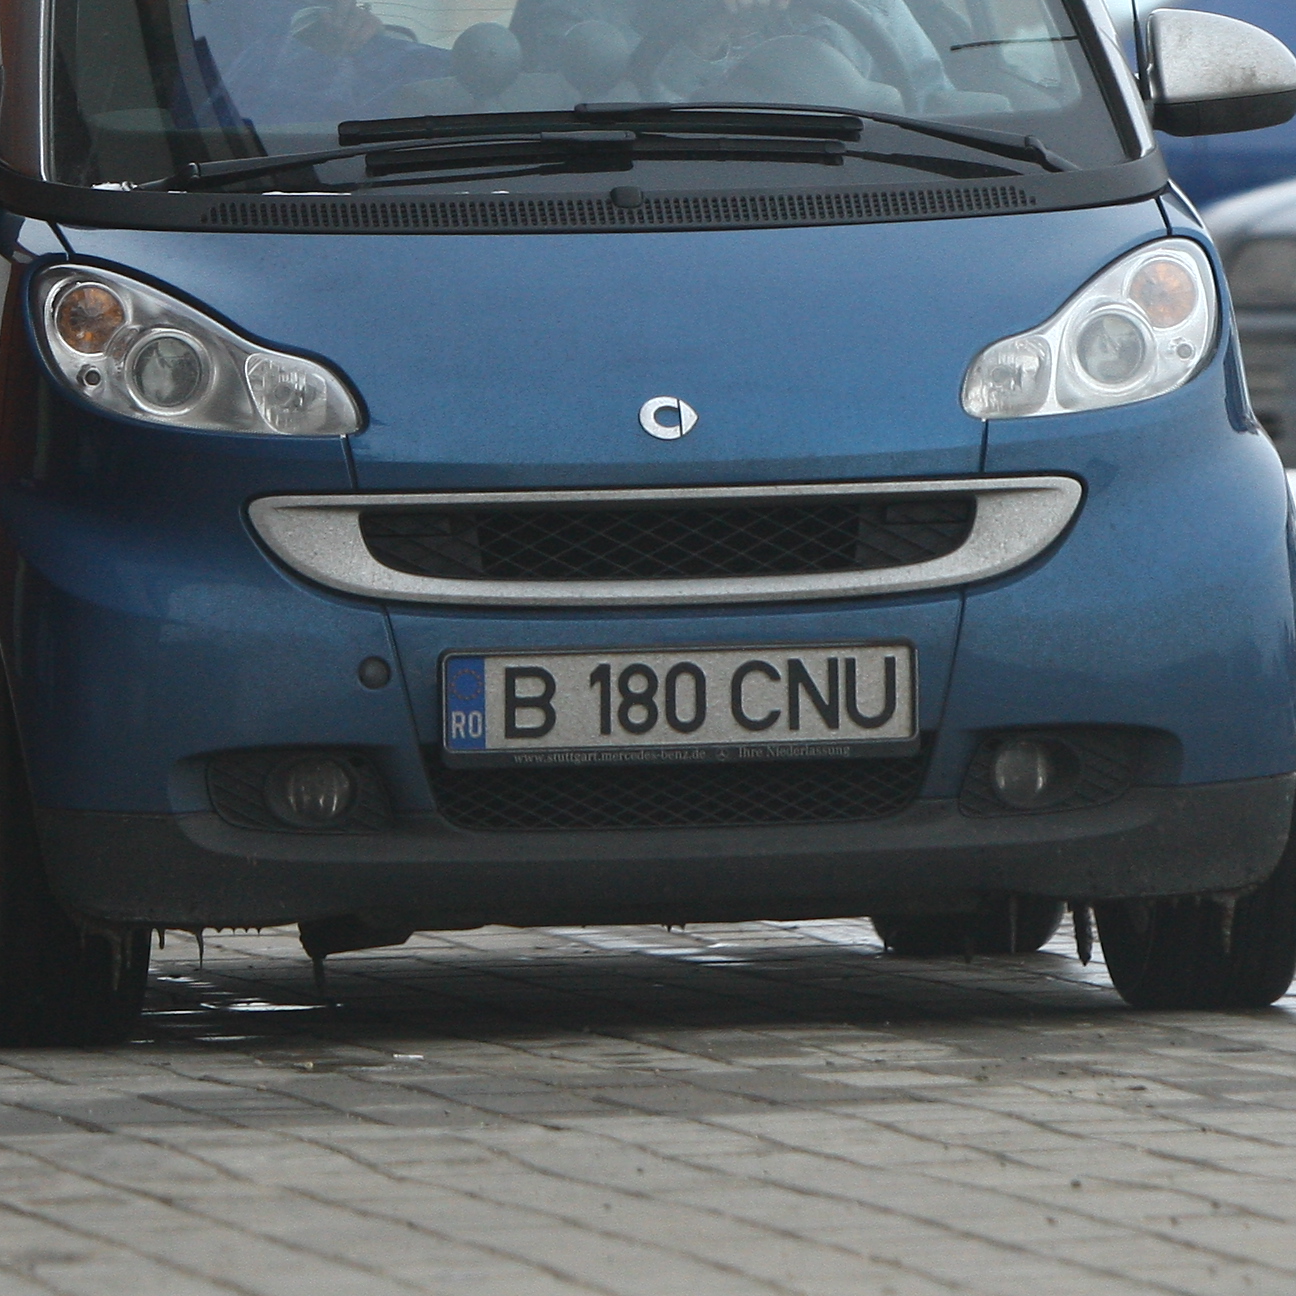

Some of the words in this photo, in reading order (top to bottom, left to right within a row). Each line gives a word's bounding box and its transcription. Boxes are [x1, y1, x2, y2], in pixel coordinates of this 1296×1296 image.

[505, 666, 556, 739] B
[590, 661, 707, 735] 180
[731, 655, 897, 731] CNU
[451, 710, 483, 739] RO
[513, 749, 706, 763] www.stuttgart.mercedes-benz.de
[738, 745, 764, 758] Ihre
[766, 744, 851, 758] Niederlassung
